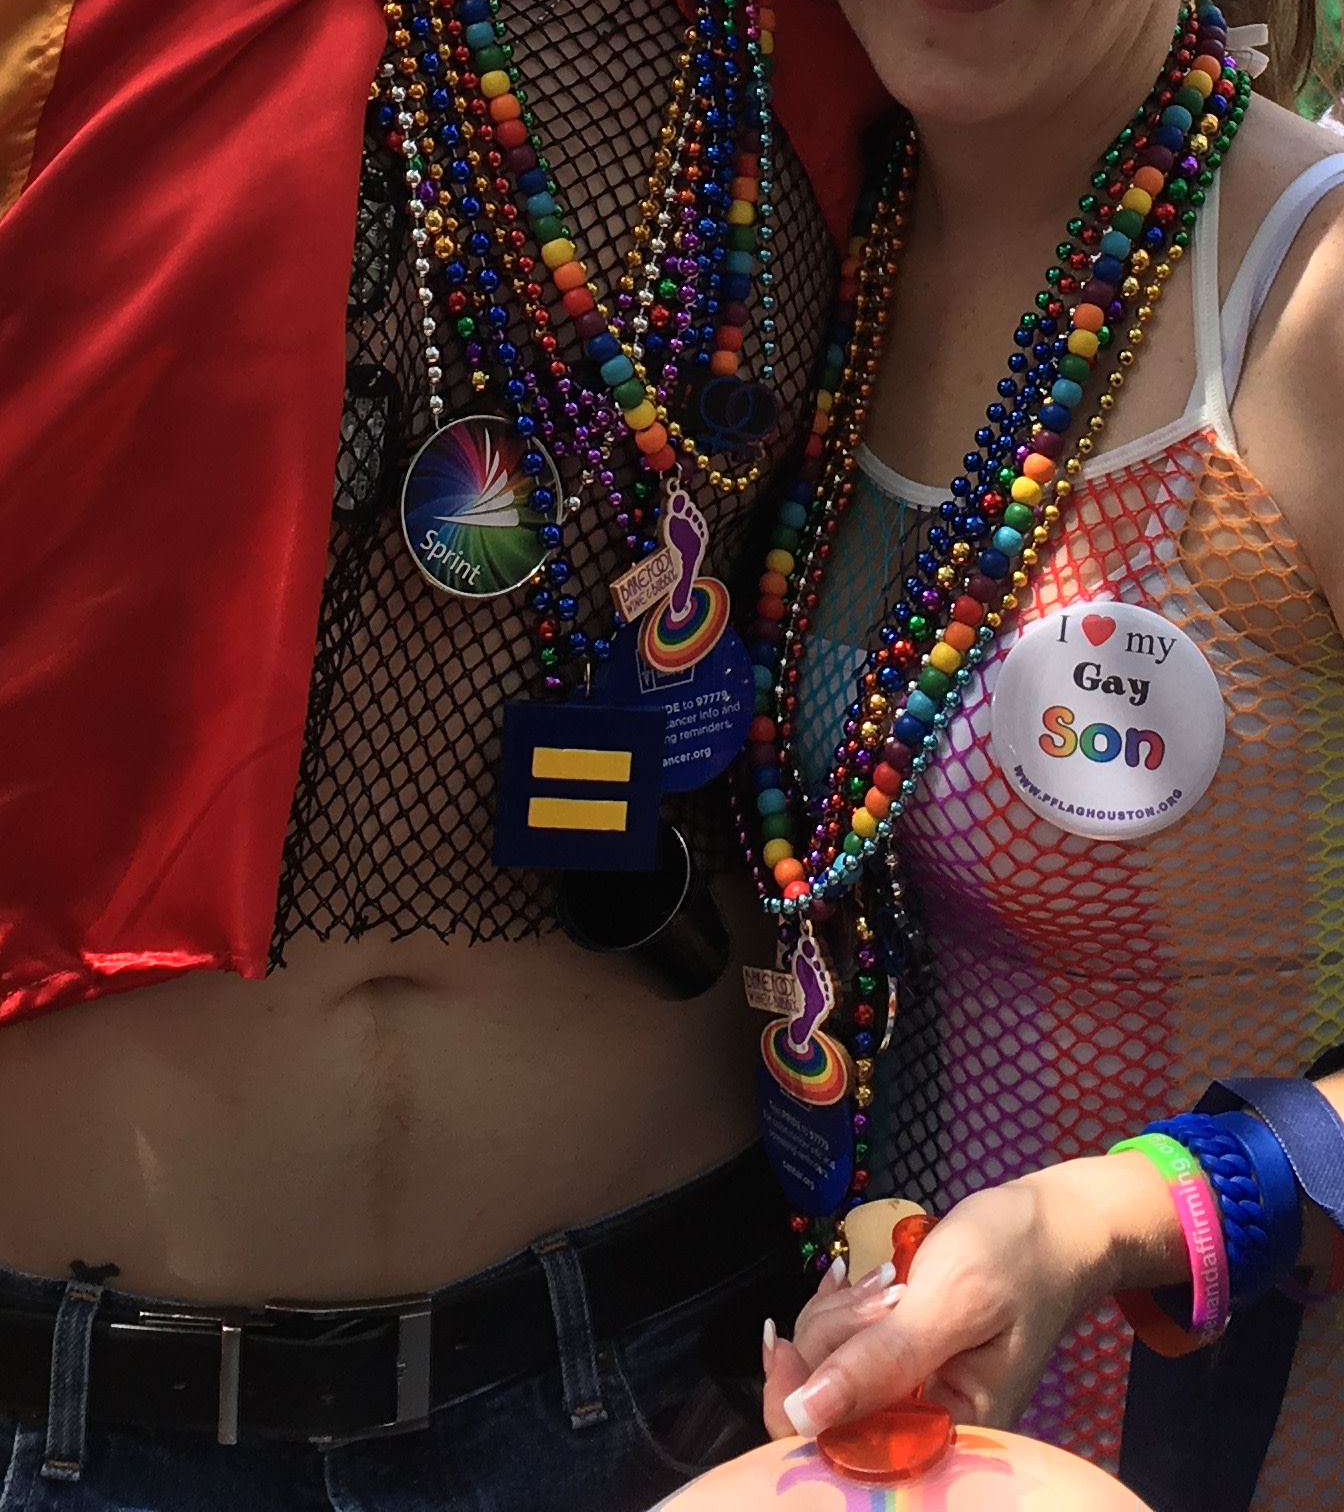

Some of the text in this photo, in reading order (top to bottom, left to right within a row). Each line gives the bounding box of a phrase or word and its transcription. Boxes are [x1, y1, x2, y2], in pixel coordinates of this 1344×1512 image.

[419, 529, 481, 586] Sprint
[1056, 614, 1177, 665] I my
[682, 700, 694, 711] to
[1072, 661, 1151, 706] Gay
[699, 708, 719, 720] info
[721, 701, 741, 714] and
[662, 746, 712, 768] ancer.org
[1038, 704, 1165, 771] Son
[1013, 764, 1183, 821] WWW.PFLAGHOUSTON.ORG
